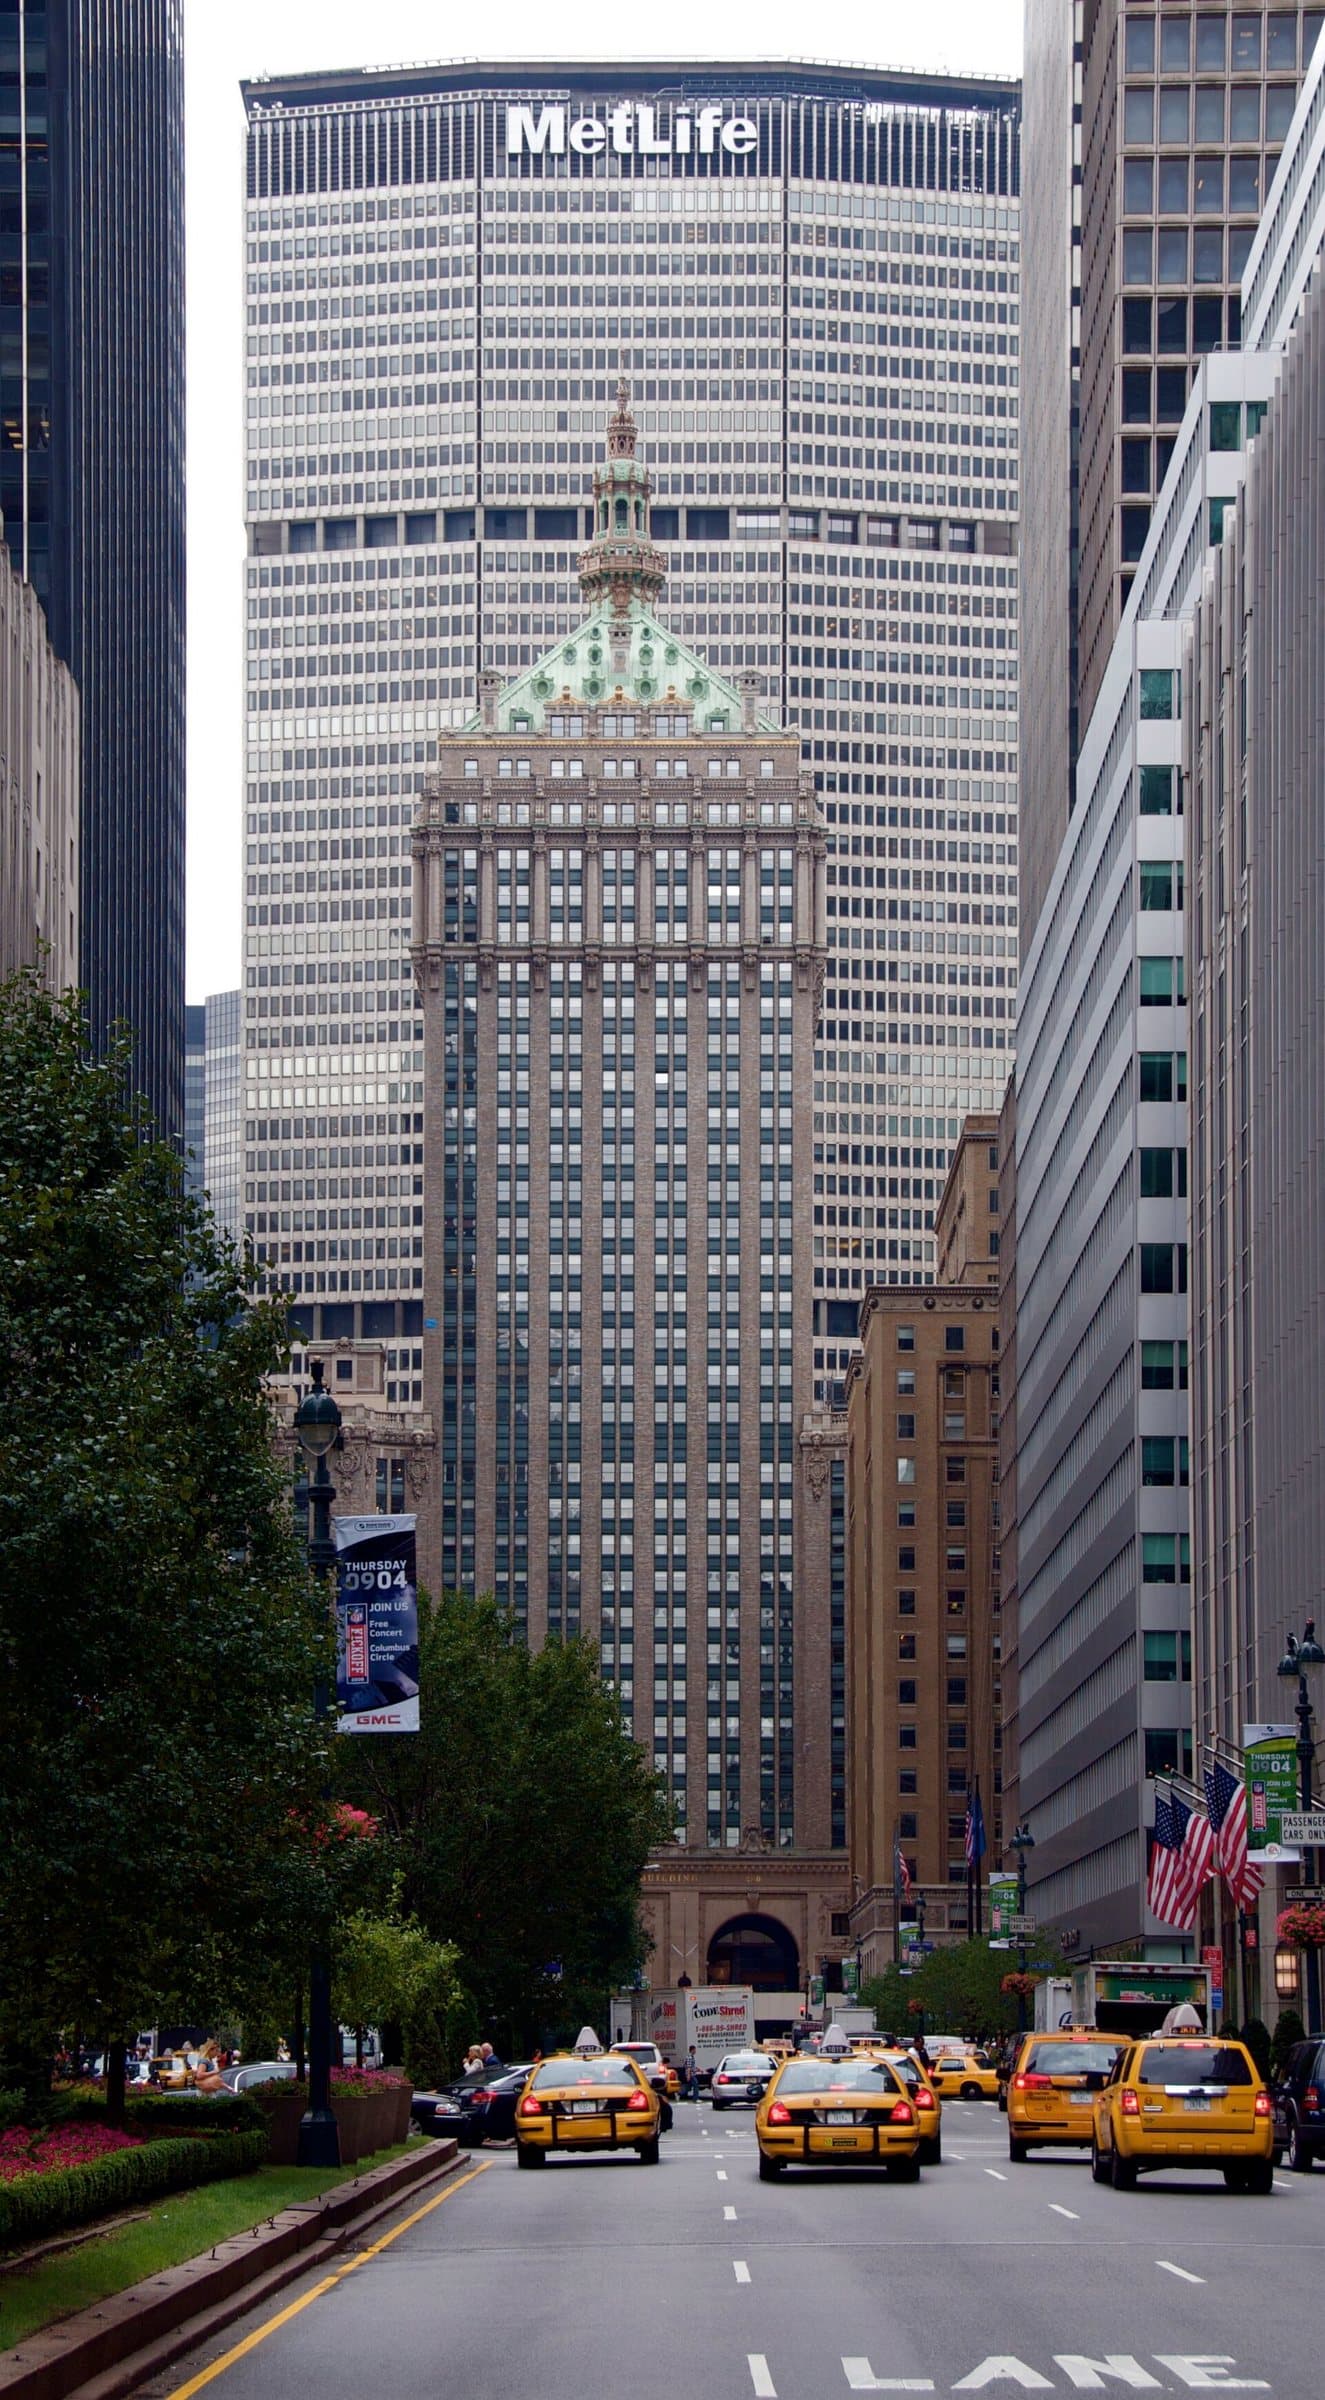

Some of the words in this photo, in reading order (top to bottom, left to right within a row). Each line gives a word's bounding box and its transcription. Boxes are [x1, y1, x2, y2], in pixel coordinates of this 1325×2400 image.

[507, 106, 758, 154] MetLife
[345, 1560, 407, 1572] THURSDAY
[345, 1570, 408, 1591] 0904
[369, 1602, 392, 1612] JOIN
[394, 1602, 409, 1611] US
[369, 1620, 389, 1628] Free
[369, 1629, 403, 1637] Concert
[351, 1628, 364, 1674] KICKOFF
[370, 1643, 410, 1652] Columbus
[370, 1653, 395, 1662] Circle
[356, 1714, 401, 1725] GMC
[1251, 1760, 1291, 1773] 0904
[1283, 1829, 1304, 1840] CARS
[841, 2354, 1270, 2391] LANE
